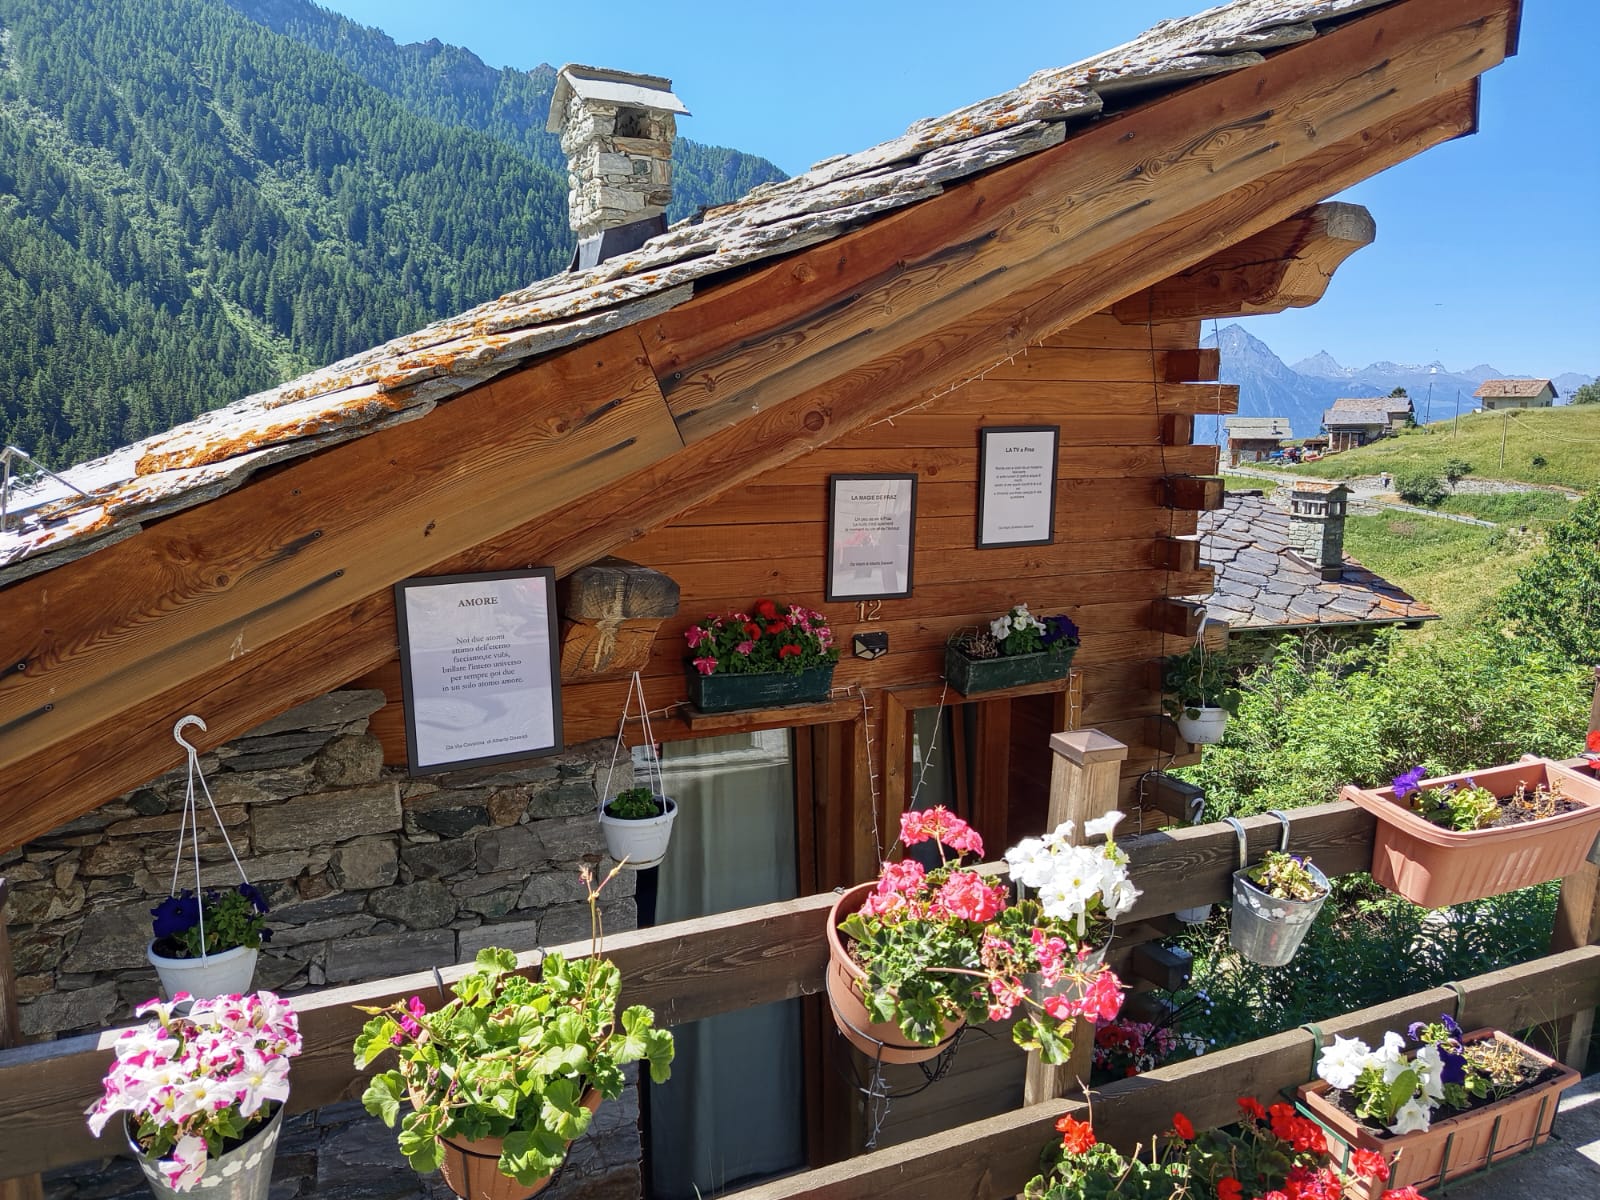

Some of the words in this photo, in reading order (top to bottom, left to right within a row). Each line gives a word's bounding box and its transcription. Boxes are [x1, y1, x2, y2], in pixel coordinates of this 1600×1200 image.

[457, 596, 499, 608] AMORE
[858, 599, 882, 623] 12
[471, 635, 485, 644] due
[450, 675, 462, 684] per
[464, 671, 489, 681] sempre
[502, 667, 516, 676] due
[442, 685, 450, 693] in
[451, 684, 461, 692] un
